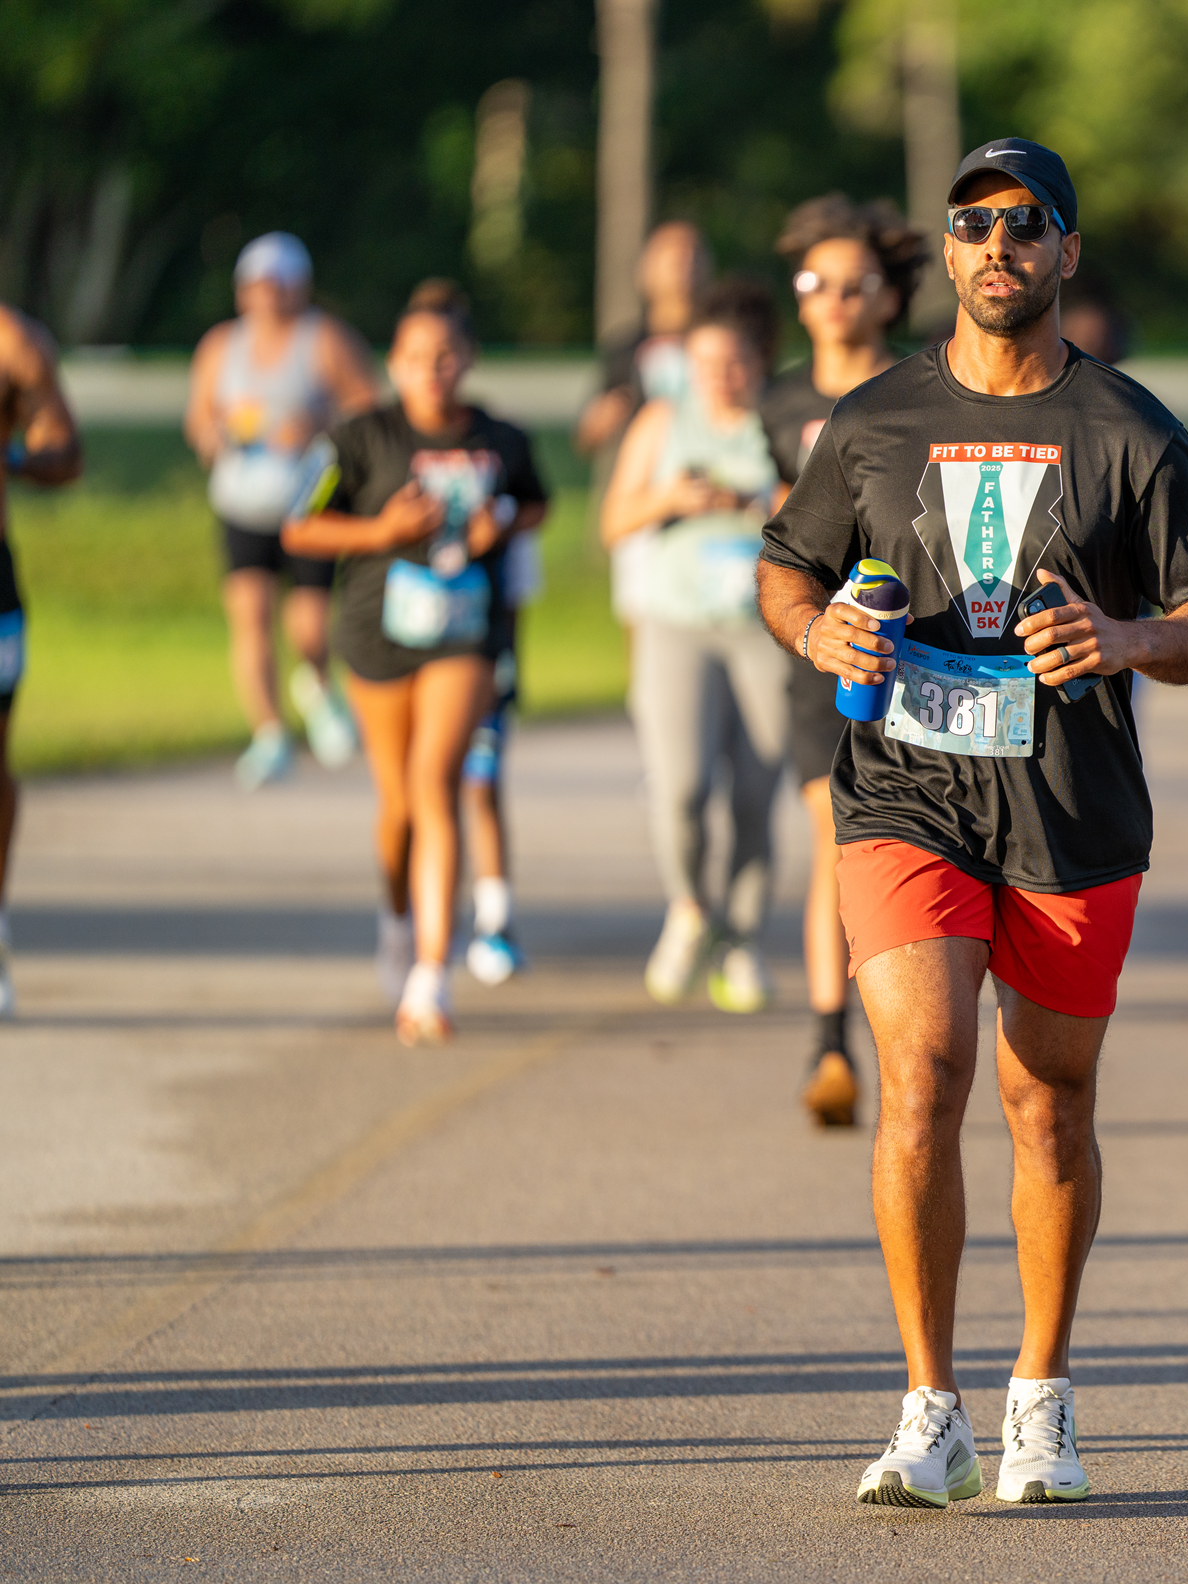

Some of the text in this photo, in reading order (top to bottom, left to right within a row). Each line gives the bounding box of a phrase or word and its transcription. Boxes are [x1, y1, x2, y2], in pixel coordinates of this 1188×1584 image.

[932, 445, 1059, 460] FIT TO BE TIED
[981, 482, 996, 585] FATHERS
[971, 601, 1006, 614] DAY
[976, 616, 1001, 629] 5K
[913, 652, 930, 661] DEPOT
[919, 681, 999, 738] 381
[989, 748, 1003, 756] 381
